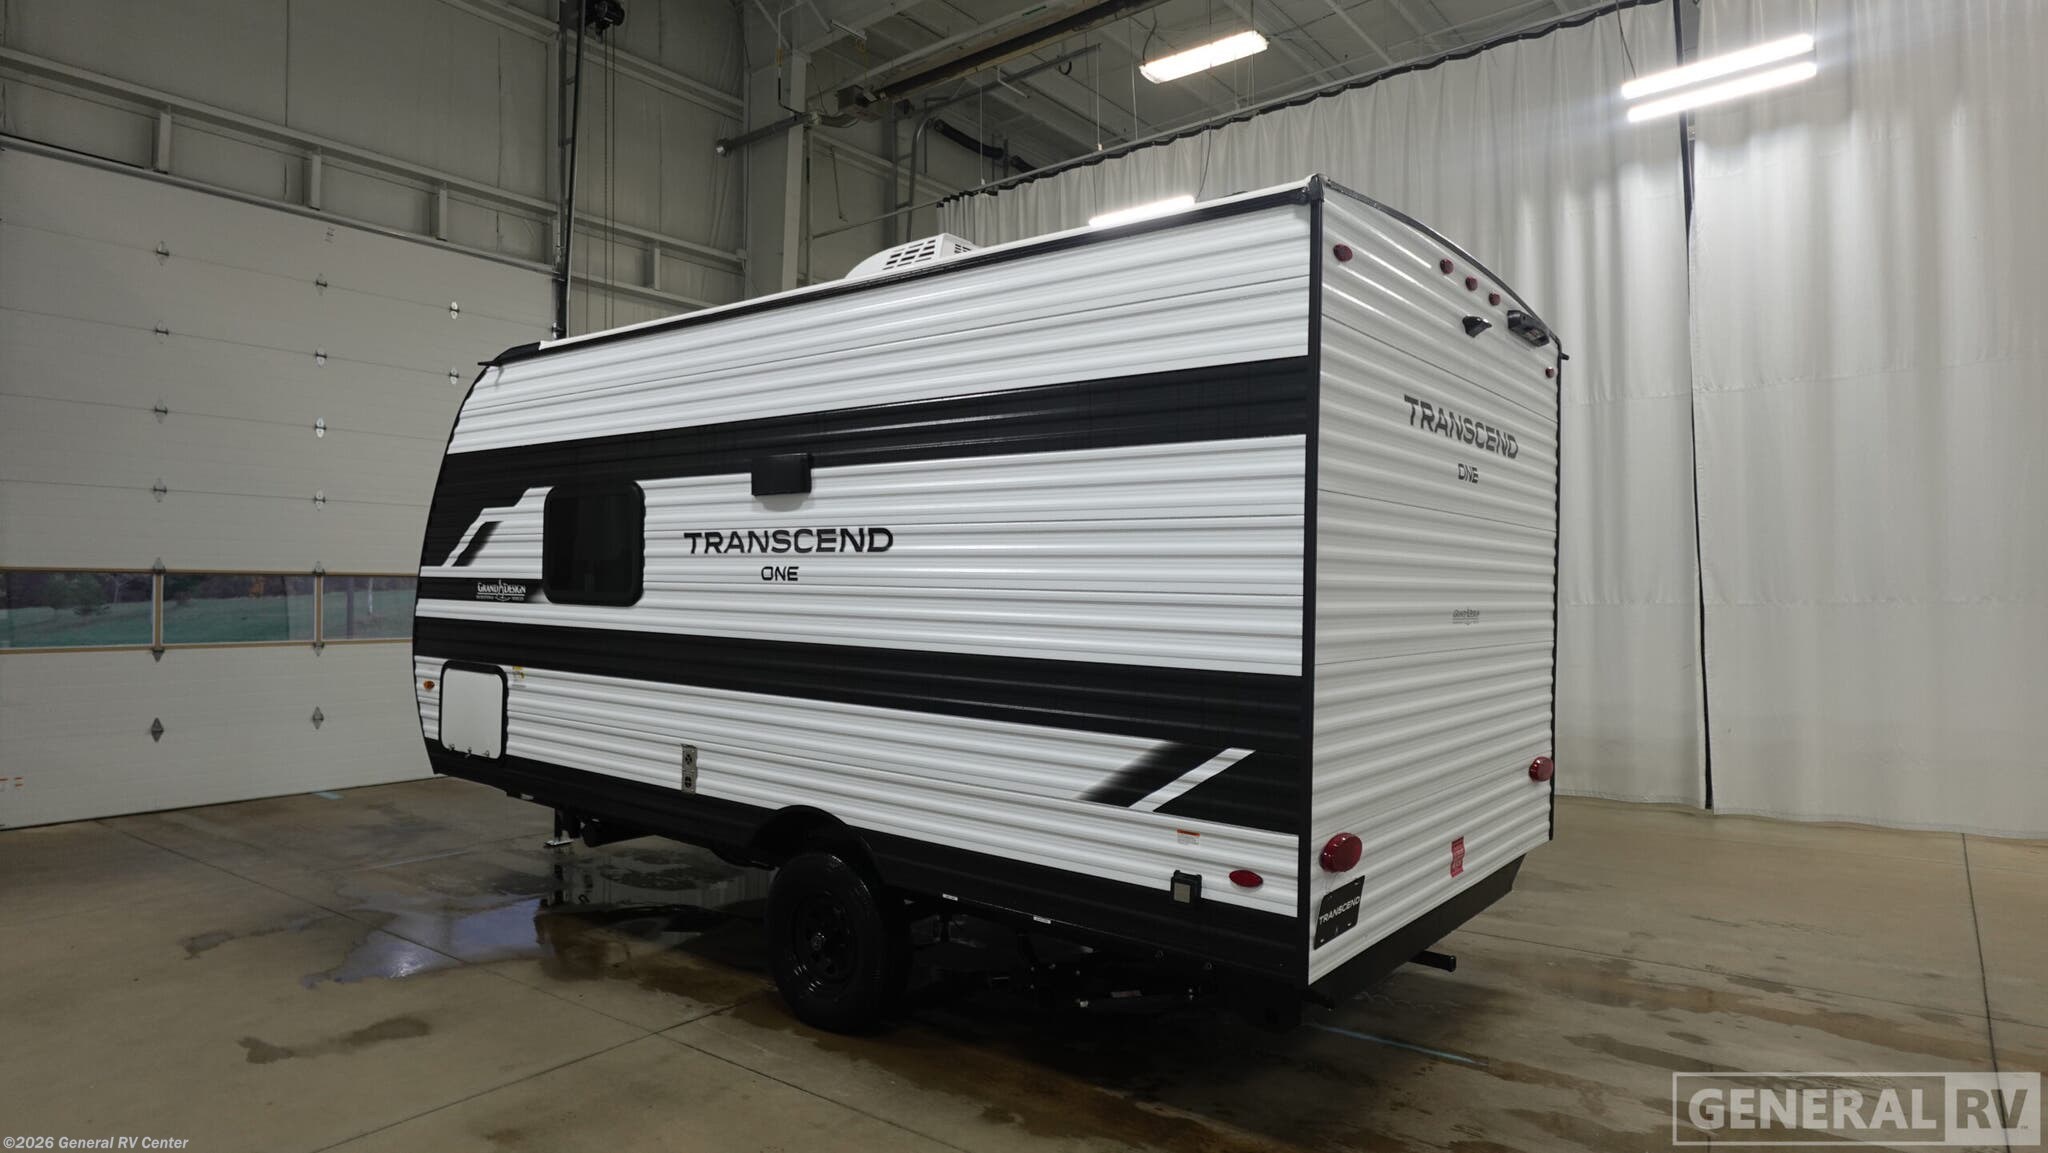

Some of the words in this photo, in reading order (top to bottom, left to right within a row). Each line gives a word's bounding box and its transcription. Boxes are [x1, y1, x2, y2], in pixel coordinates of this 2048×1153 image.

[1404, 394, 1519, 459] TRANSCEND
[1457, 463, 1479, 484] ONE
[683, 527, 894, 554] TRANSCEND
[760, 566, 799, 582] ONE
[477, 582, 499, 593] GRAND
[503, 582, 527, 594] DESIGN
[1319, 896, 1361, 925] TRANSCEND
